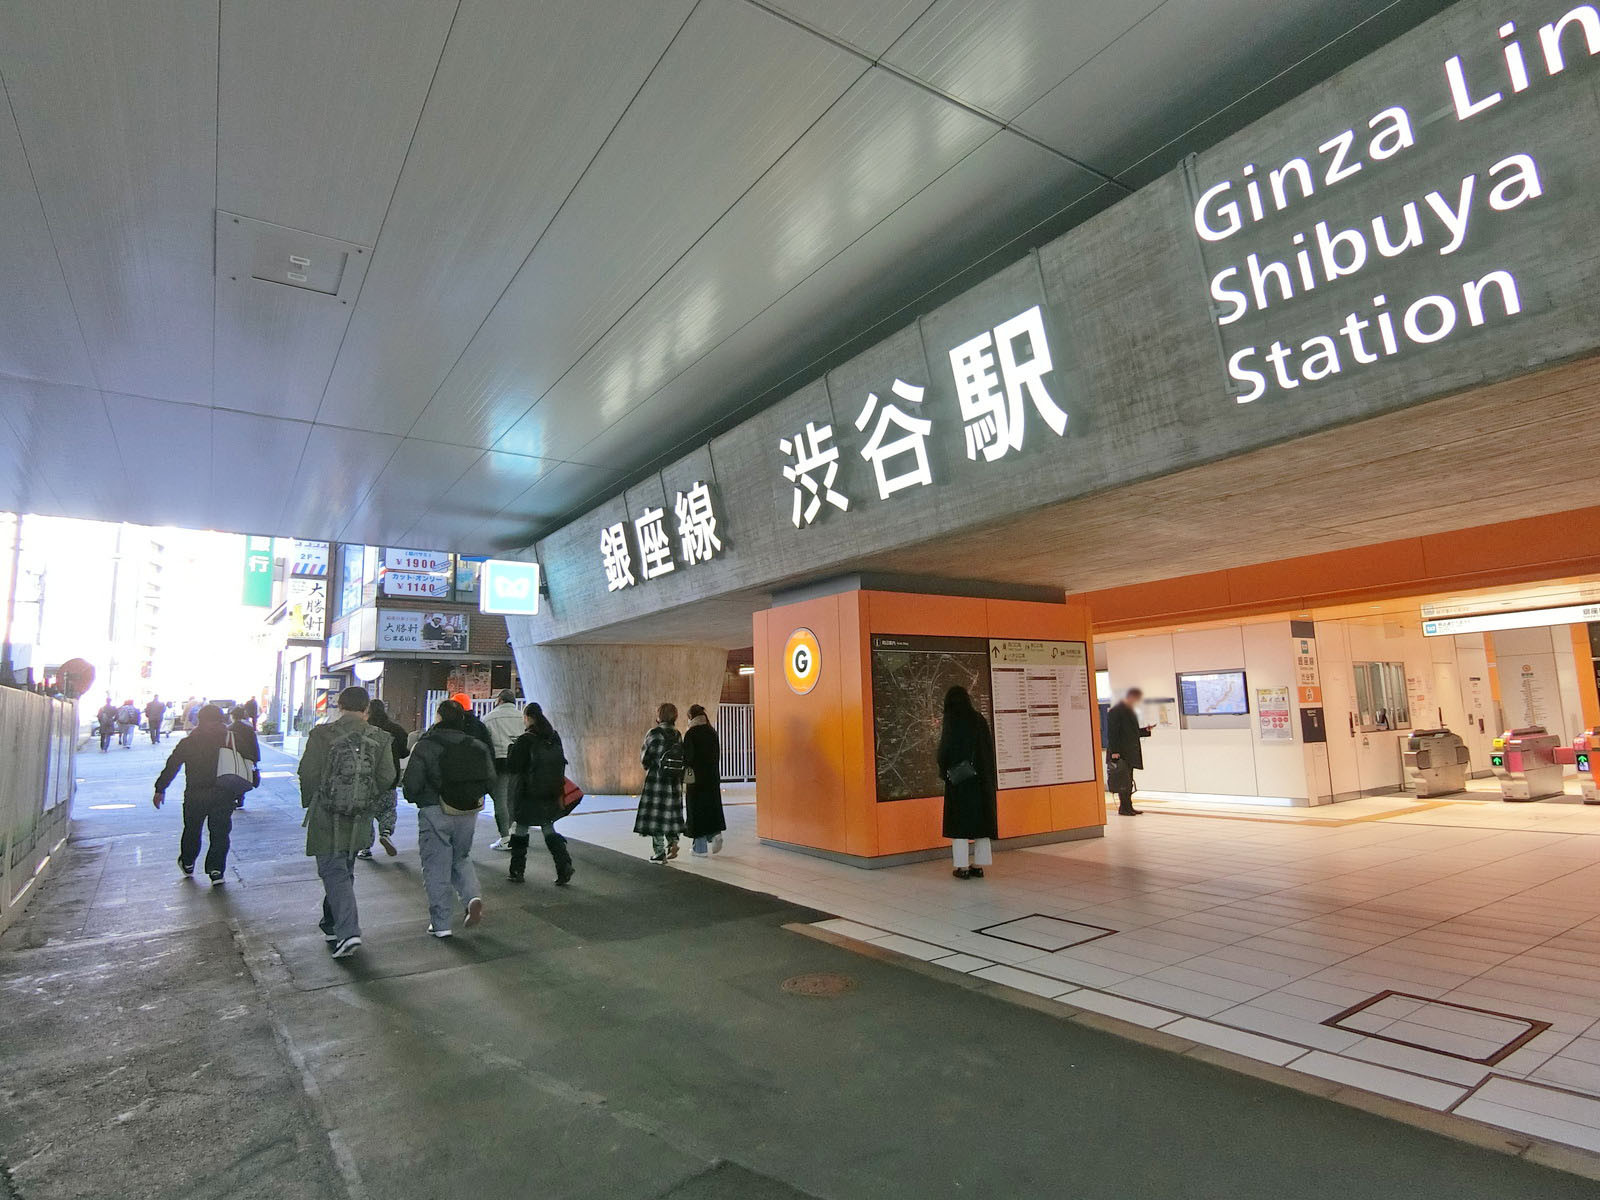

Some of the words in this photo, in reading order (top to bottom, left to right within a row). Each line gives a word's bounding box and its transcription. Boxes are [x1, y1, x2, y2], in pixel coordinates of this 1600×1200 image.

[1194, 106, 1415, 242] Ginza
[1210, 152, 1543, 325] Shibuya
[1227, 270, 1522, 404] Station
[600, 480, 721, 592] 銀座線
[779, 304, 1069, 529] 渋谷駅
[795, 650, 808, 673] G
